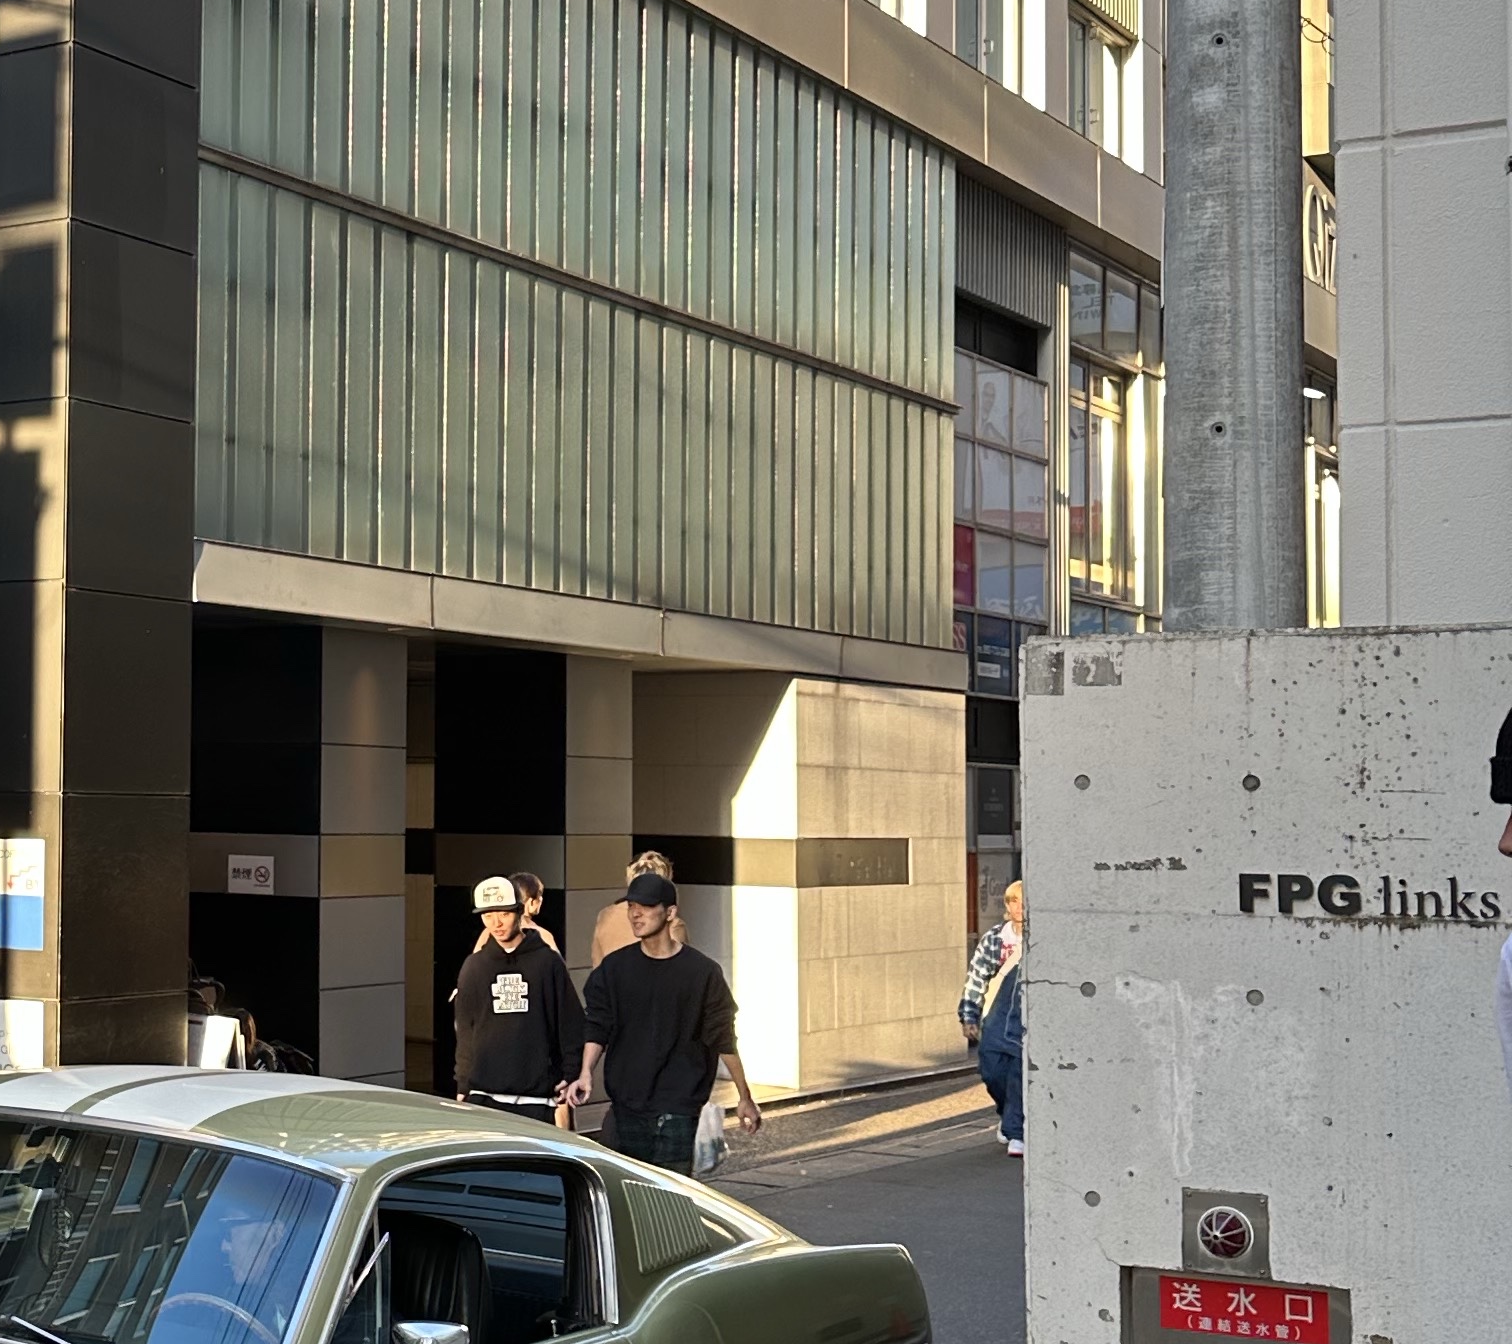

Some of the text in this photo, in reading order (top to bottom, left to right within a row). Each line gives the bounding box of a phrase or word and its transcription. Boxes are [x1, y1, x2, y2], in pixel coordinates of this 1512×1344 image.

[1238, 873, 1501, 920] FPG links
[1172, 1282, 1313, 1324] 送水口
